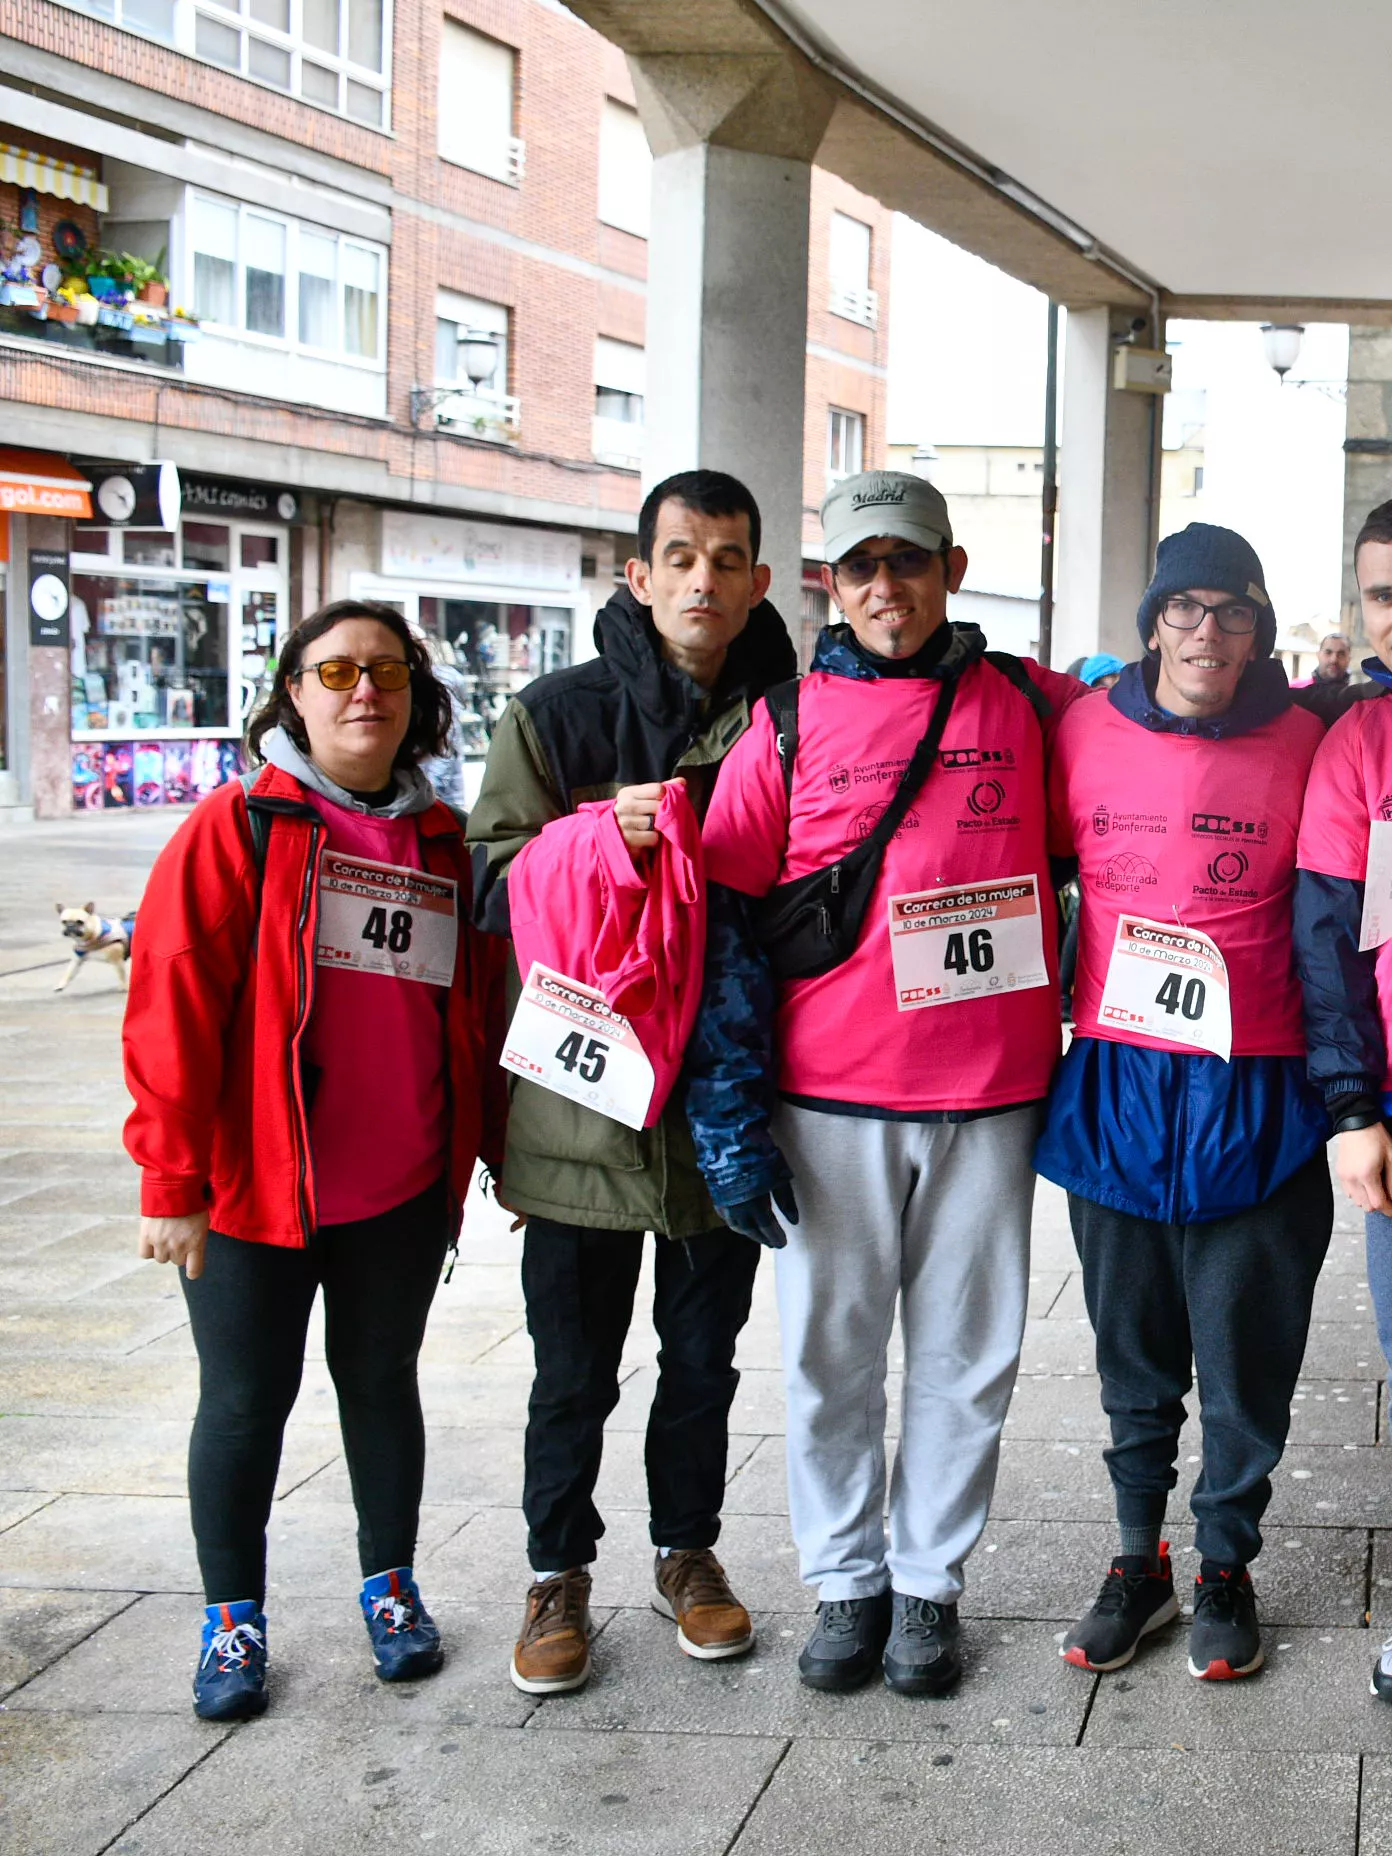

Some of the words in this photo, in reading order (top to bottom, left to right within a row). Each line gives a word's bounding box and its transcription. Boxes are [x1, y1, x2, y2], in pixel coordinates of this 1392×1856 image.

[851, 489, 906, 505] Madrid
[854, 758, 910, 773] Ayuntamient
[957, 820, 982, 829] Pacto
[992, 816, 1020, 826] Estado
[1112, 822, 1167, 834] Ponferrada
[1113, 812, 1168, 822] Ayuntamiento
[332, 862, 384, 881] Carrera
[386, 874, 402, 885] de
[404, 876, 414, 887] la
[415, 882, 448, 897] mujer
[1104, 881, 1140, 893] deporte
[1107, 867, 1158, 885] Ponferrada
[329, 877, 338, 889] 10
[341, 881, 353, 891] de
[355, 884, 392, 900] Marzo
[394, 891, 418, 904] 2024
[903, 897, 954, 914] Carrera
[957, 893, 972, 905] de
[976, 893, 987, 903] la
[989, 886, 1027, 902] mujer
[1192, 885, 1218, 895] Pacto
[1228, 887, 1259, 898] Estado
[362, 906, 413, 954] 48
[903, 920, 912, 930] 10
[914, 917, 926, 927] de
[928, 914, 966, 926] Marzo
[969, 908, 993, 919] 2024
[944, 928, 995, 976] 46
[1132, 926, 1186, 948] Carrera
[1187, 940, 1201, 953] de
[1202, 943, 1210, 956] la
[1128, 942, 1137, 952] 10
[1140, 946, 1151, 955] de
[1153, 949, 1191, 964] Marzo
[1193, 958, 1211, 971] 2024
[541, 978, 592, 1008] Carrera
[594, 1002, 611, 1015] de
[1155, 972, 1206, 1021] 40
[545, 999, 556, 1008] de
[559, 1004, 596, 1026] Marzo
[598, 1021, 621, 1038] 2024
[555, 1031, 610, 1083] 45
